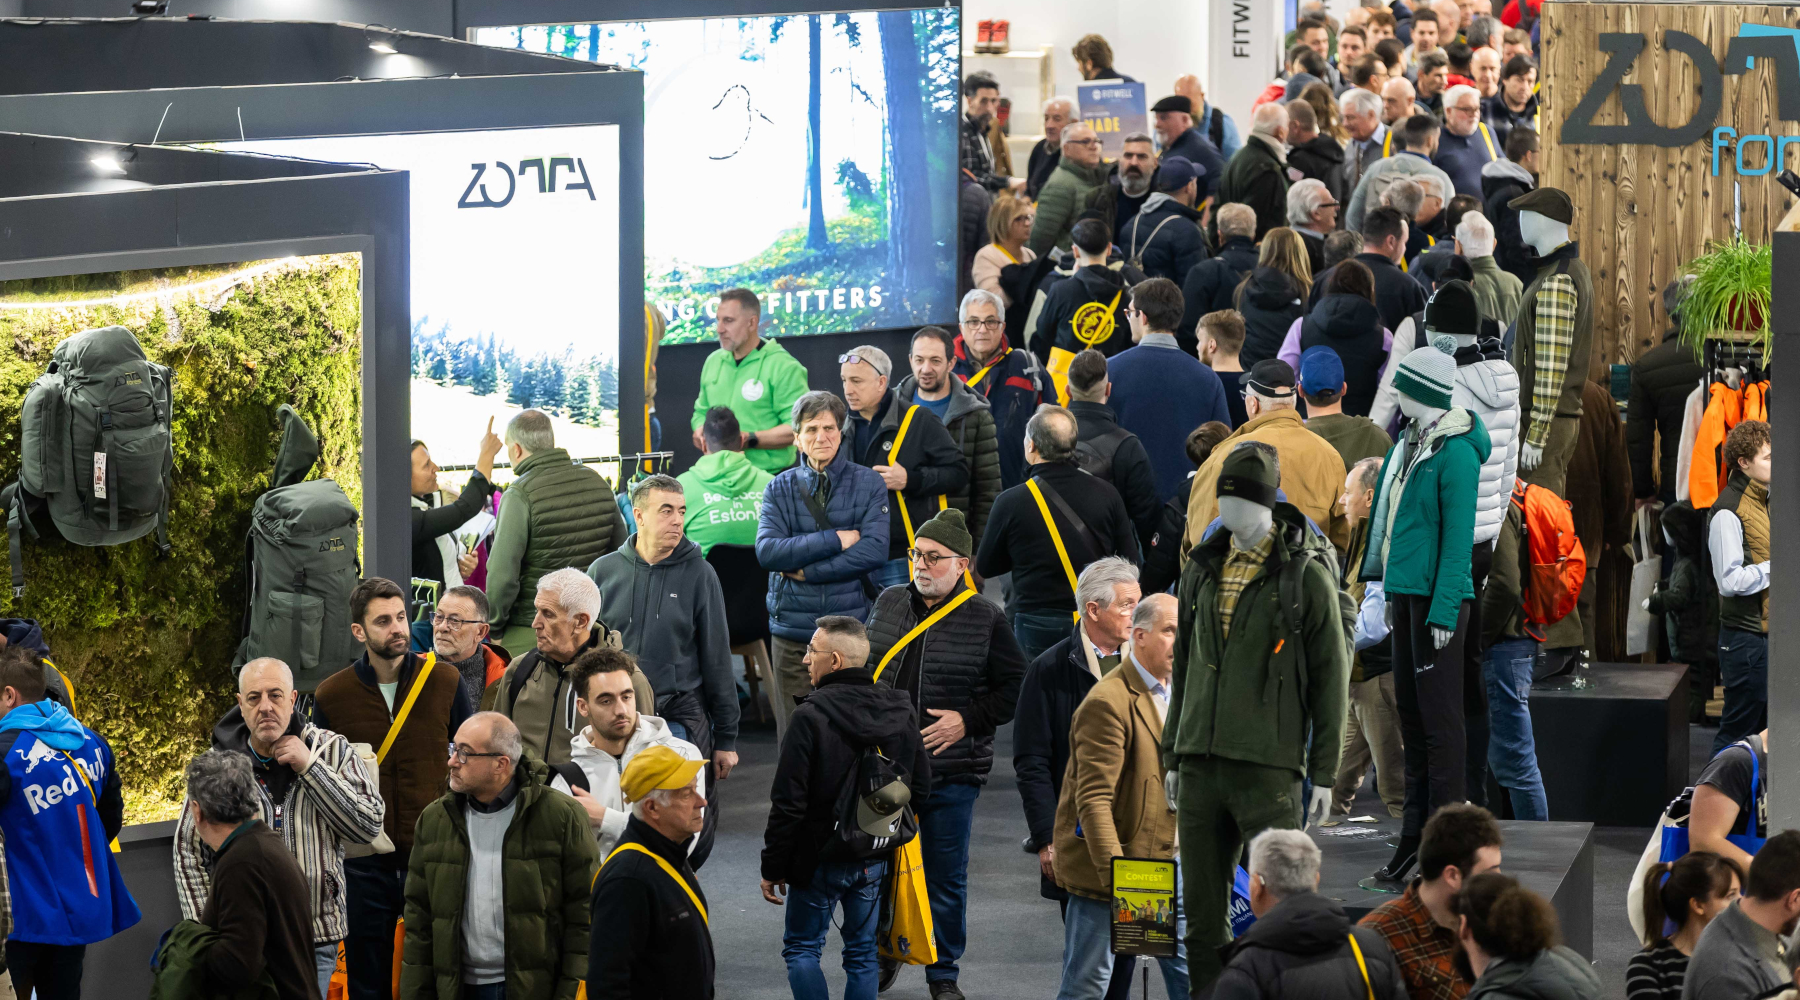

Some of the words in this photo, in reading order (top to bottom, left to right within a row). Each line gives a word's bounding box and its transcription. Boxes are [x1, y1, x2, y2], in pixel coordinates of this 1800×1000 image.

[1233, 0, 1250, 57] FITW
[458, 156, 597, 209] ZOTTA
[23, 764, 79, 815] Red
[1126, 873, 1163, 882] CONTEST
[1229, 897, 1249, 919] MI
